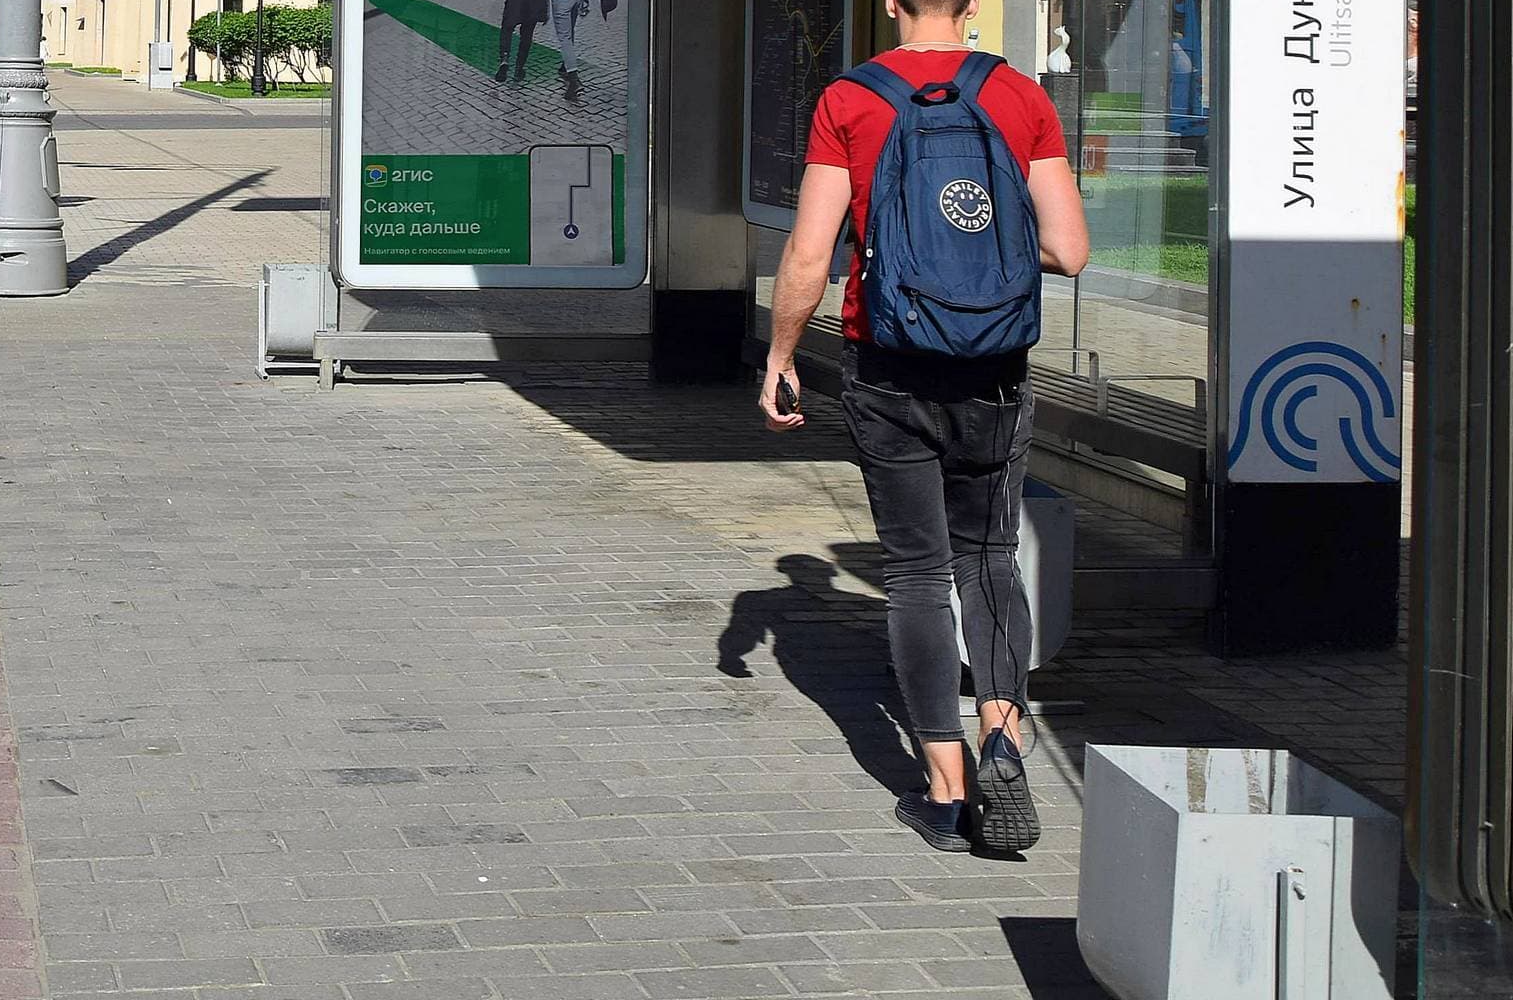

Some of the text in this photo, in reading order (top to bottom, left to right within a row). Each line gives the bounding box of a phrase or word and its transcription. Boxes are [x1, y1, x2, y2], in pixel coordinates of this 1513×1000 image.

[1283, 87, 1319, 209] Улица
[391, 169, 433, 182] 2ГИС
[364, 198, 436, 216] Скажет,
[942, 182, 990, 228] SMILEY ORIGINALS
[363, 222, 481, 238] куда дальше
[364, 247, 410, 255] Навигатор
[418, 248, 466, 256] голосовым
[467, 248, 511, 256] ведением
